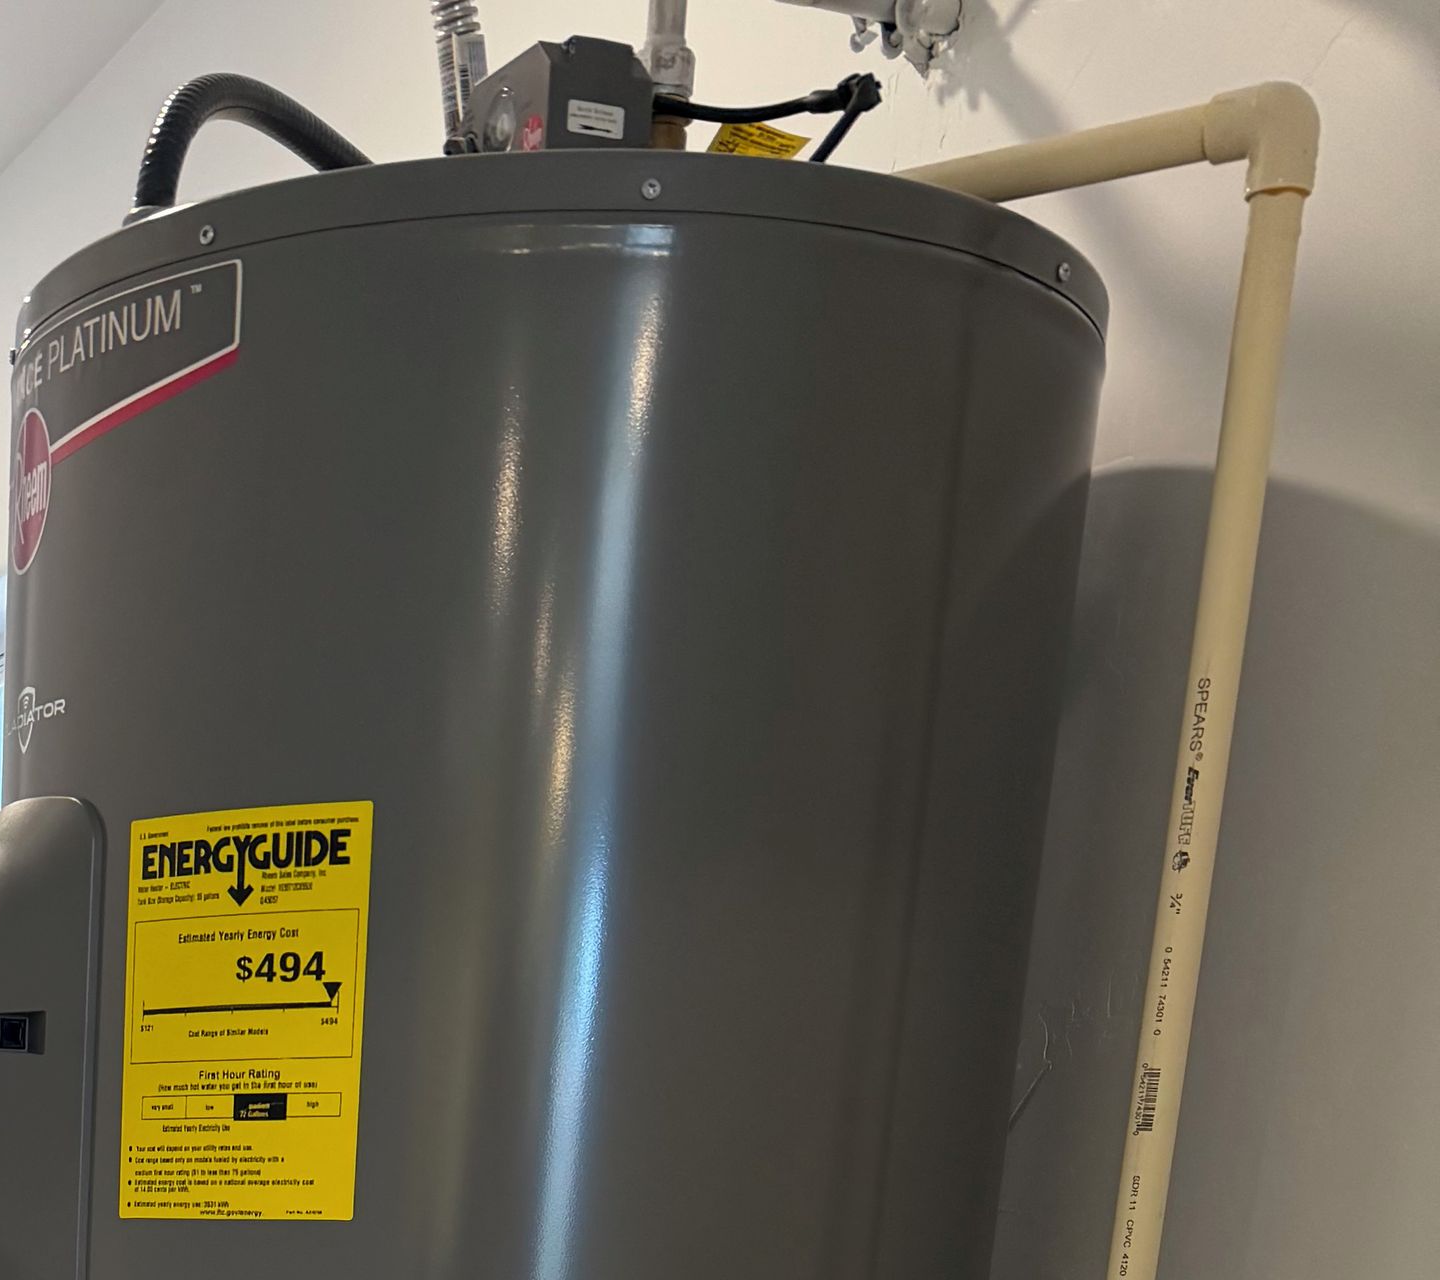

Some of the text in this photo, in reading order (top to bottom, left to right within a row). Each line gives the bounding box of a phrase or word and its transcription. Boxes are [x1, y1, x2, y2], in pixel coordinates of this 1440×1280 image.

[47, 290, 181, 380] PLATINUM
[142, 829, 351, 881] ENERGYGUIDE
[178, 927, 299, 944] Estimated Yearly Energy Cost
[236, 951, 326, 982] $494
[321, 1017, 338, 1026] $494
[199, 1069, 281, 1081] First Hour Rating
[1122, 1220, 1134, 1248] CPVC
[1119, 1253, 1130, 1277] 4120
